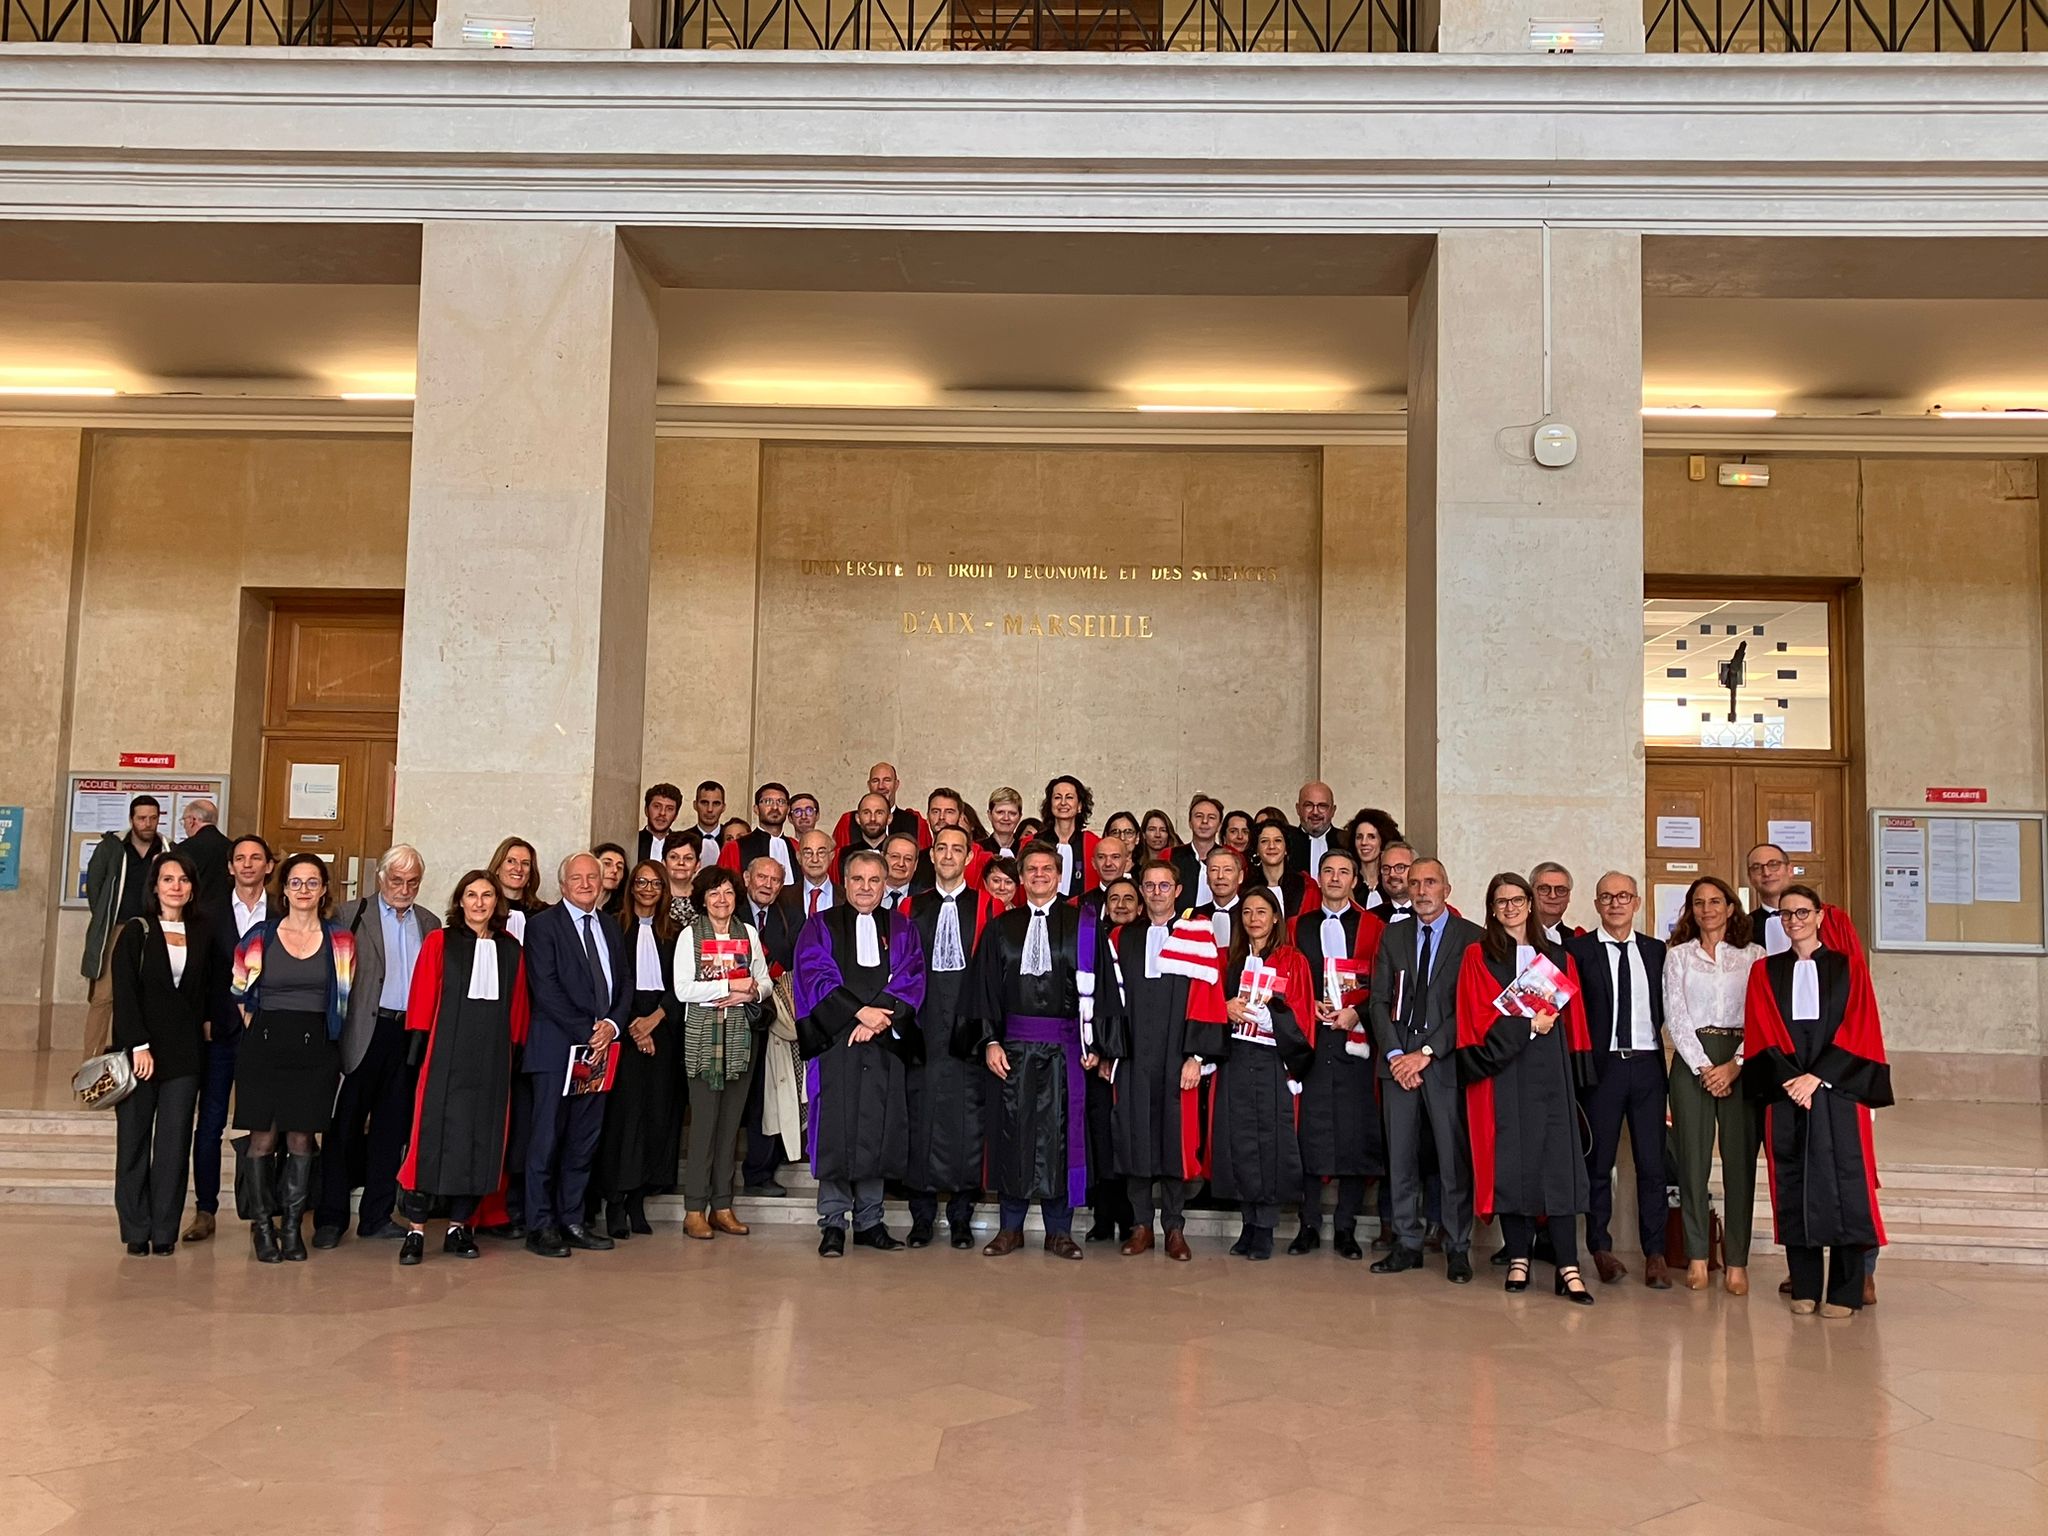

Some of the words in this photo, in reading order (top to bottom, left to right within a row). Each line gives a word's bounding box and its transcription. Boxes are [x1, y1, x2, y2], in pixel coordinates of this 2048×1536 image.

[917, 562, 936, 577] DE
[948, 563, 994, 578] DROIT
[1119, 565, 1140, 580] ET
[1151, 565, 1183, 581] DES
[1191, 566, 1278, 582] SCIENCES
[902, 610, 975, 634] D'AIX
[1002, 613, 1154, 638] MARSEILLE
[134, 756, 169, 765] SCOLARITÉ
[79, 780, 116, 790] ACCUEIL
[1942, 790, 1980, 799] SCOLARITÉ
